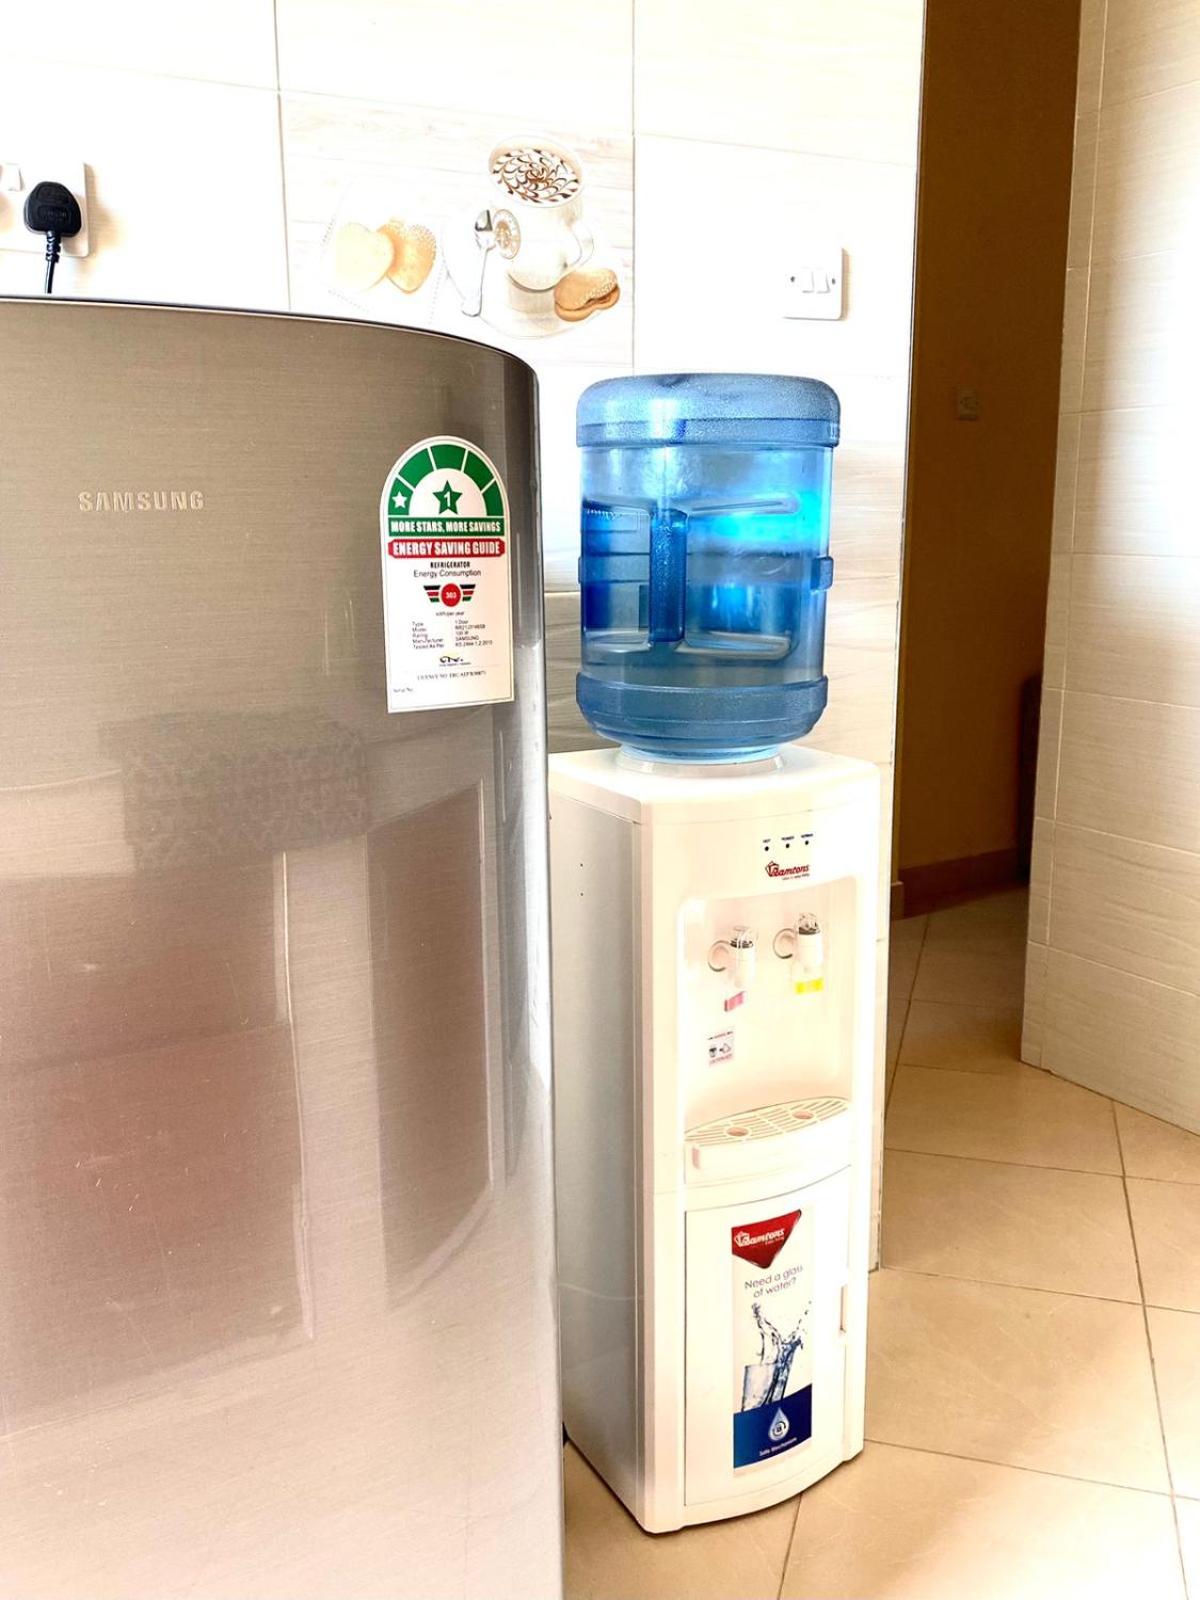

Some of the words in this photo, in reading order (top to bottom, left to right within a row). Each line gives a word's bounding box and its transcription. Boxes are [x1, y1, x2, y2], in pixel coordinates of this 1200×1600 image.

[78, 490, 204, 512] SAMSUNG
[390, 521, 415, 533] MORE
[446, 521, 468, 533] MORE
[469, 521, 501, 533] SAVINGS
[392, 541, 433, 556] ENERGY
[434, 541, 471, 555] SAVING
[472, 541, 500, 555] GUIDE
[413, 570, 437, 578] Energy
[440, 569, 481, 577] Consumption
[744, 1275, 772, 1290] Need
[774, 1273, 781, 1281] a
[783, 1264, 804, 1280] glass
[753, 1287, 764, 1298] of
[766, 1276, 797, 1295] water?
